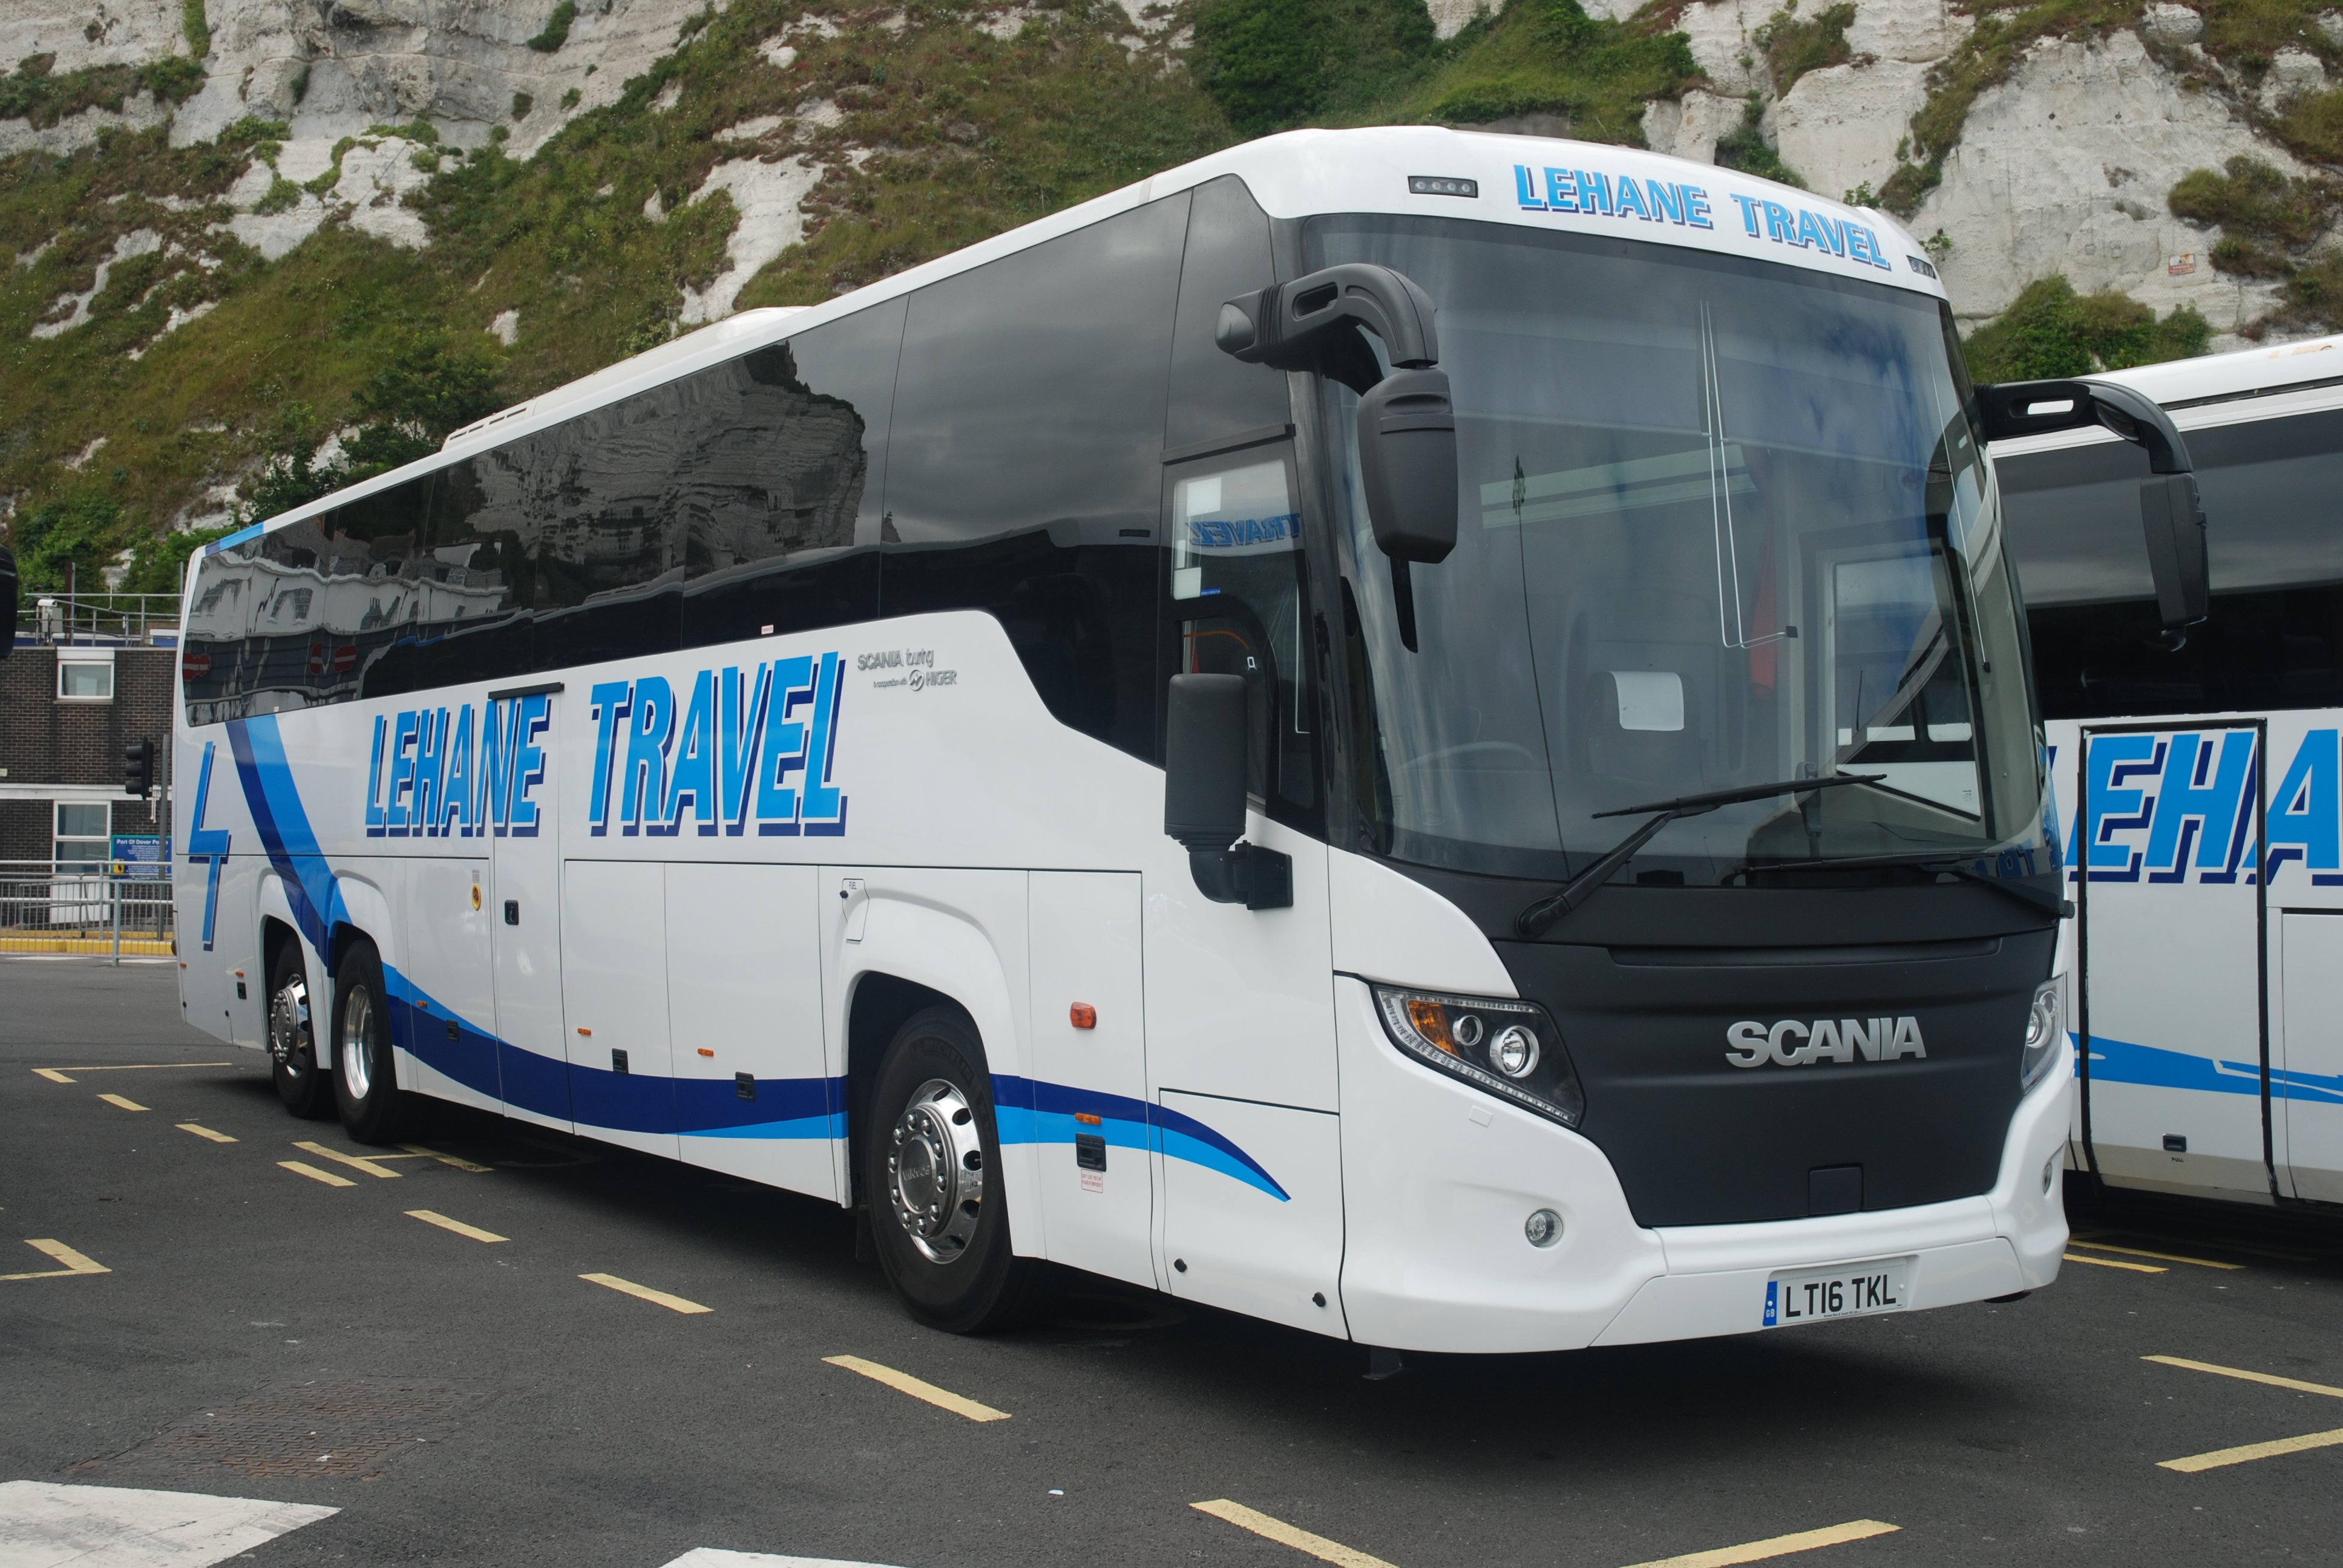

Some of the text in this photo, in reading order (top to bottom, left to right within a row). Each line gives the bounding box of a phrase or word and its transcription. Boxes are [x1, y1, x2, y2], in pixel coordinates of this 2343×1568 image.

[1513, 165, 1892, 271] LEHANE TRAVEL
[857, 650, 904, 671] SCANIA
[926, 670, 957, 686] HIGER
[365, 652, 847, 837] LEHANE TRAVEL
[1725, 1016, 1927, 1068] SCANIA
[1766, 1308, 1775, 1318] GB
[1786, 1274, 1896, 1318] LT16 TKL
